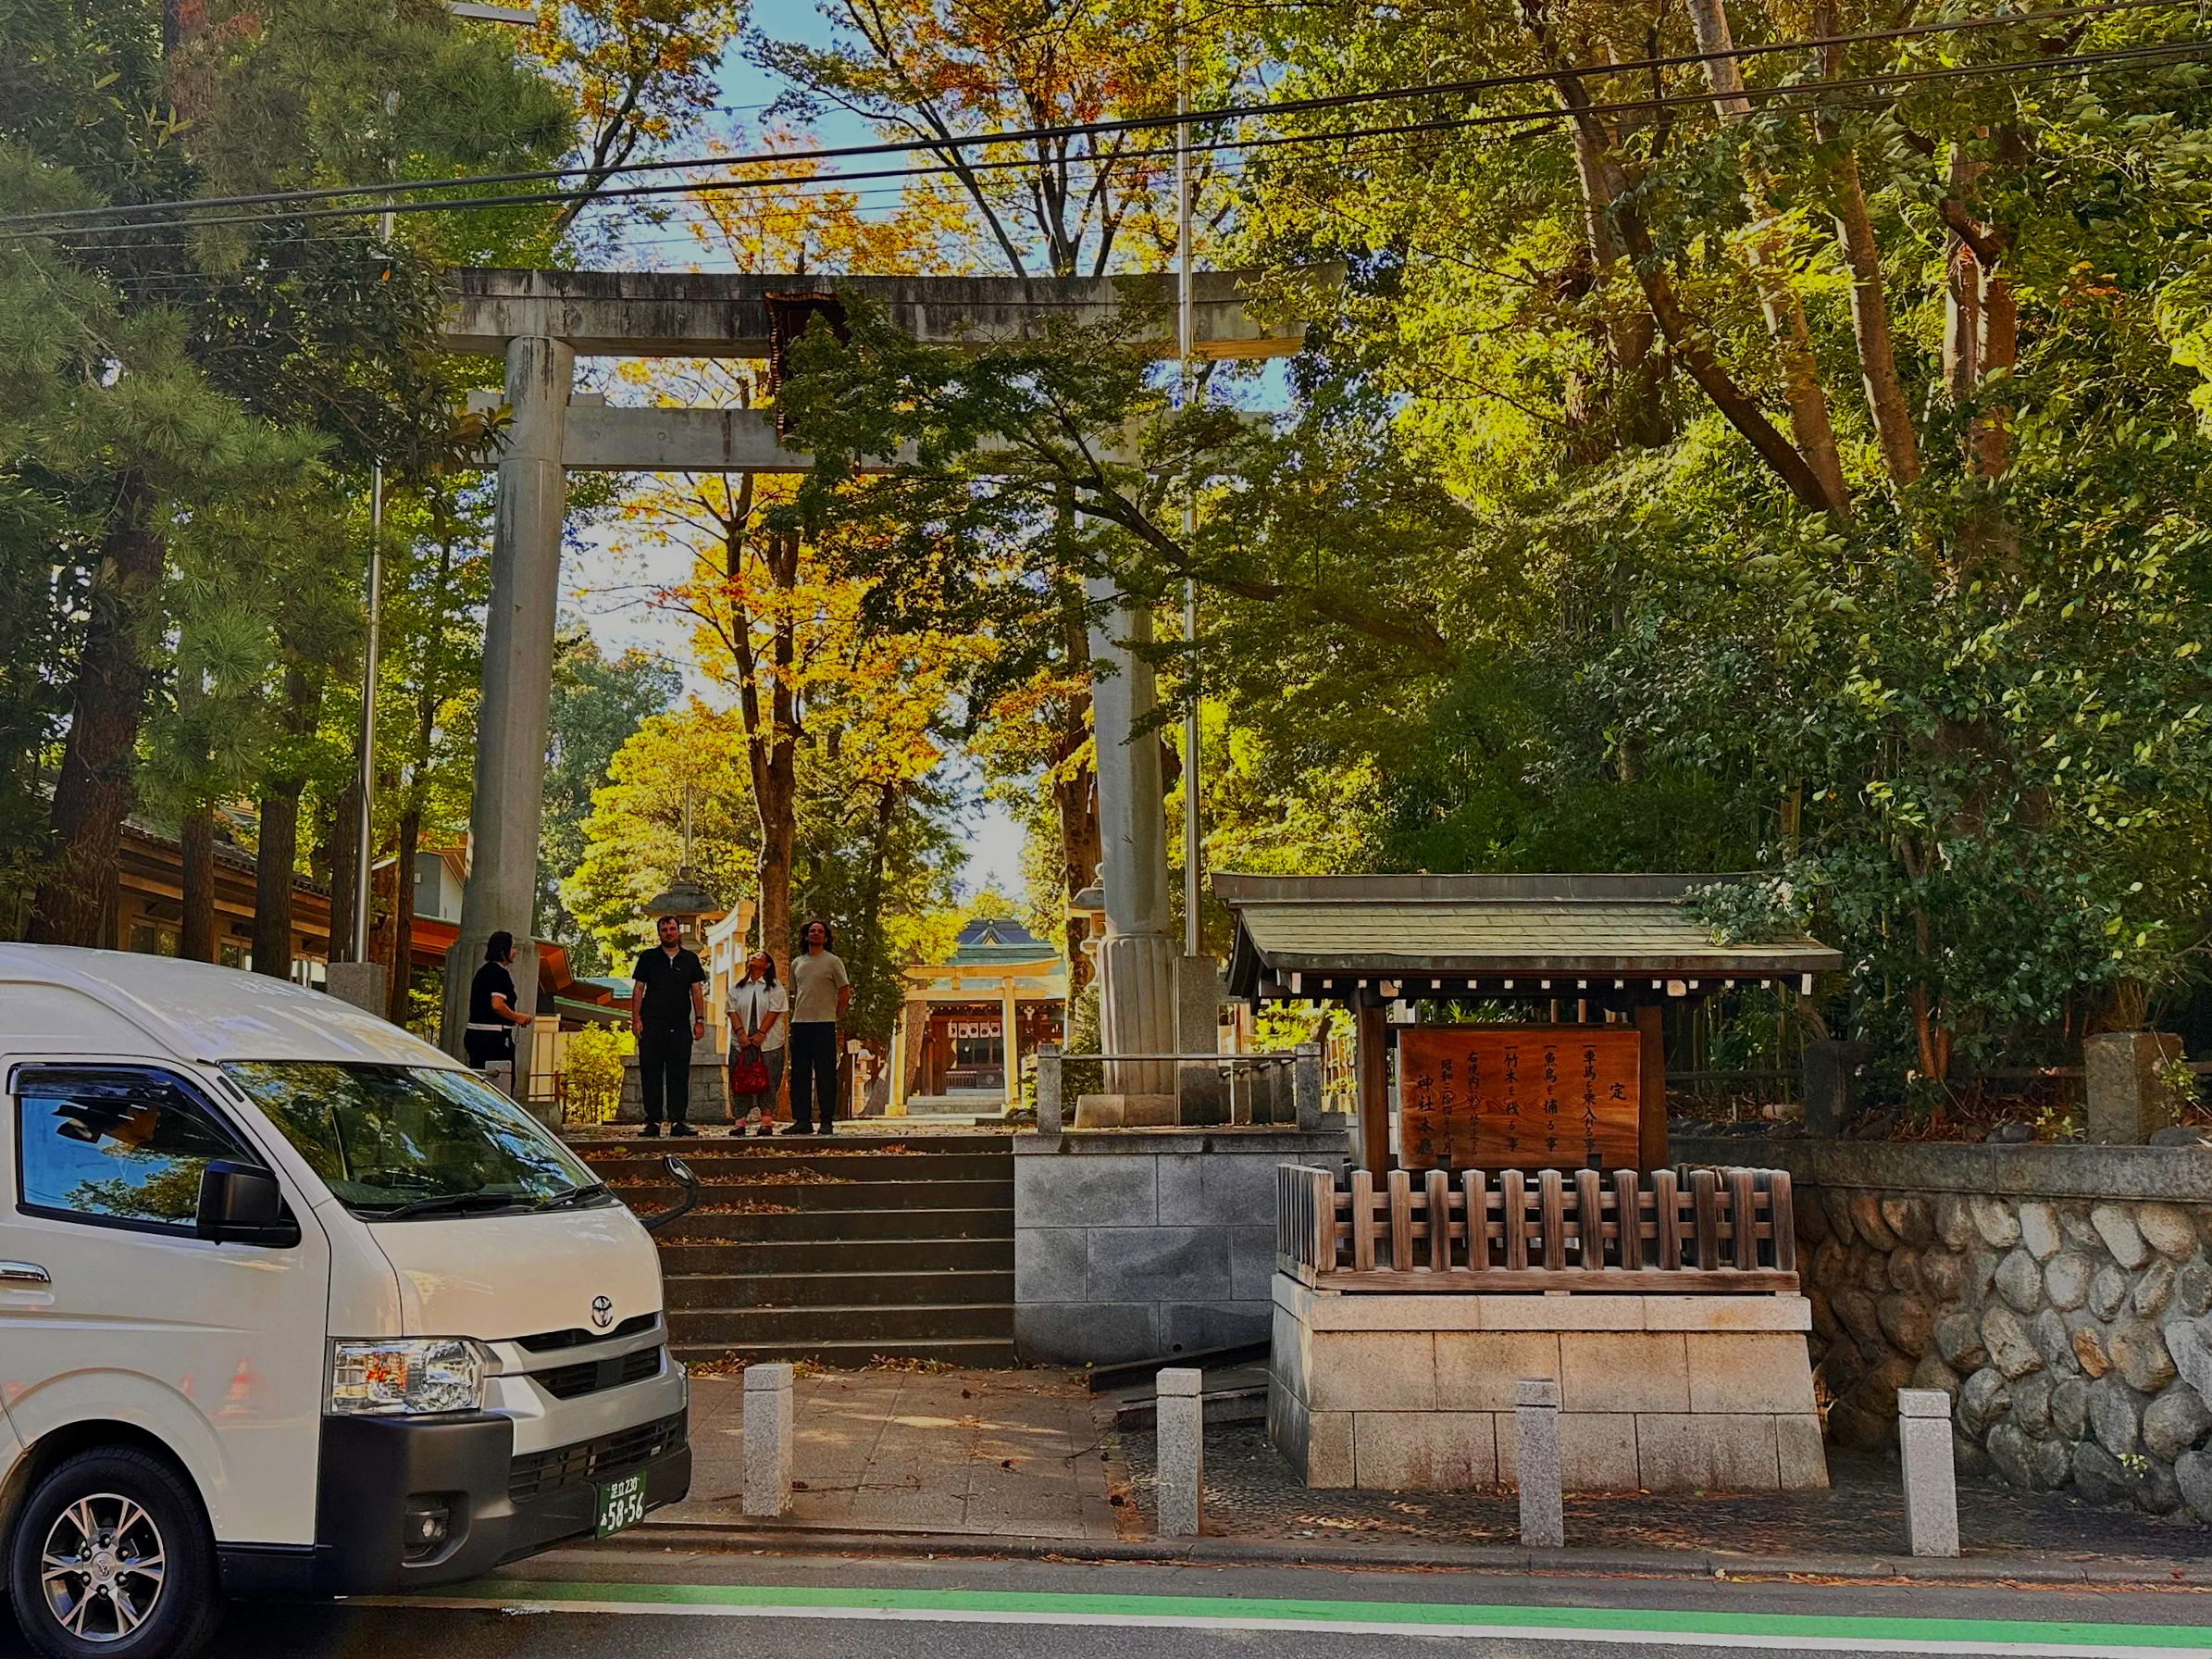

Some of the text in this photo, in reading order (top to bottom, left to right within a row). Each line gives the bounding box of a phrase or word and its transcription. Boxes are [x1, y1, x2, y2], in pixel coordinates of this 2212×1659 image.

[1609, 1082, 1627, 1101] 定
[610, 1477, 638, 1500] 足立 230
[607, 1491, 644, 1531] 58-56
